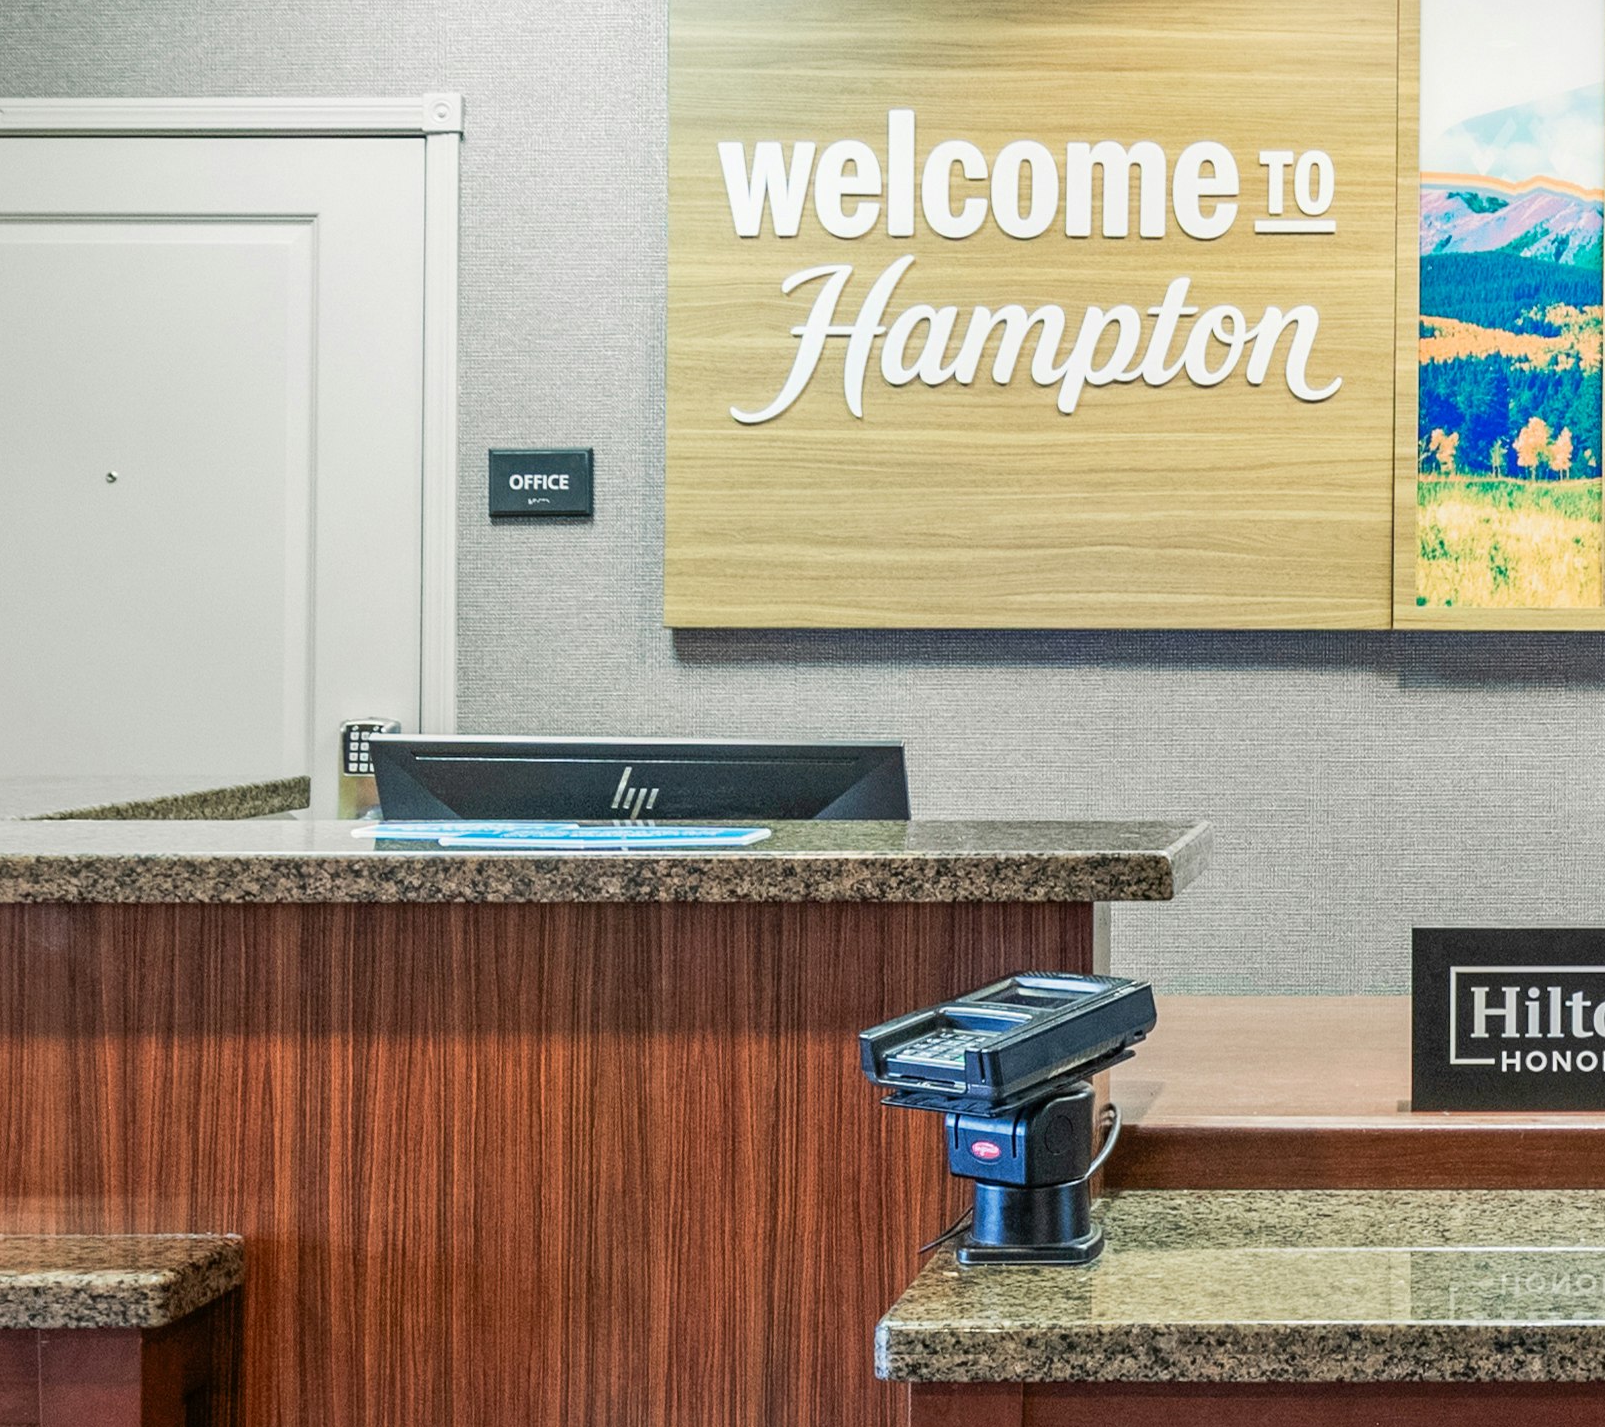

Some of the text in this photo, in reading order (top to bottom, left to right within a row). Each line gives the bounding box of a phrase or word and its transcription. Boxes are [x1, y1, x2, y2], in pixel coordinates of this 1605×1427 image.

[718, 108, 1336, 241] welcome TO
[729, 254, 1343, 425] Hampton
[509, 474, 570, 490] OFFICE
[611, 766, 660, 819] hp
